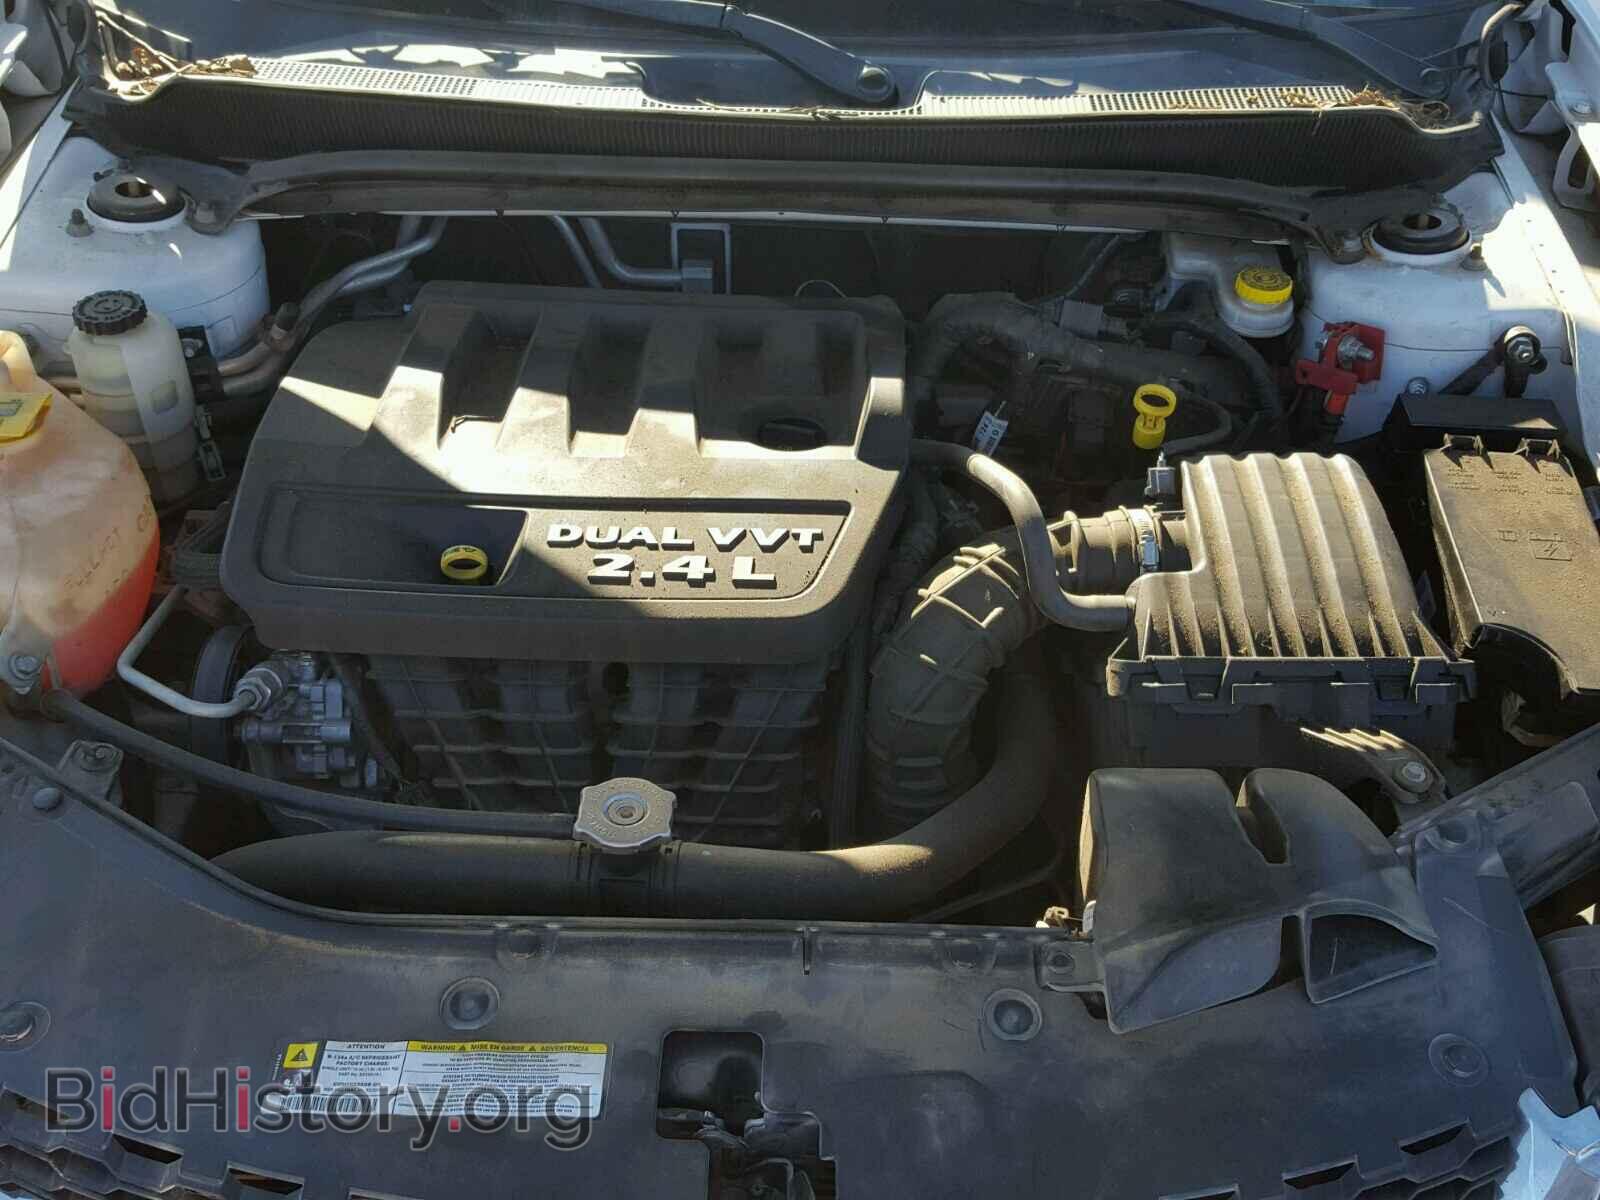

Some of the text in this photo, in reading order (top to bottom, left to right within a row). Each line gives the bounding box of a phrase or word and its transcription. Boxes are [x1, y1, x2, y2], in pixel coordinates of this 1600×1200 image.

[546, 524, 824, 553] DUAL VVT
[489, 1043, 500, 1051] EN
